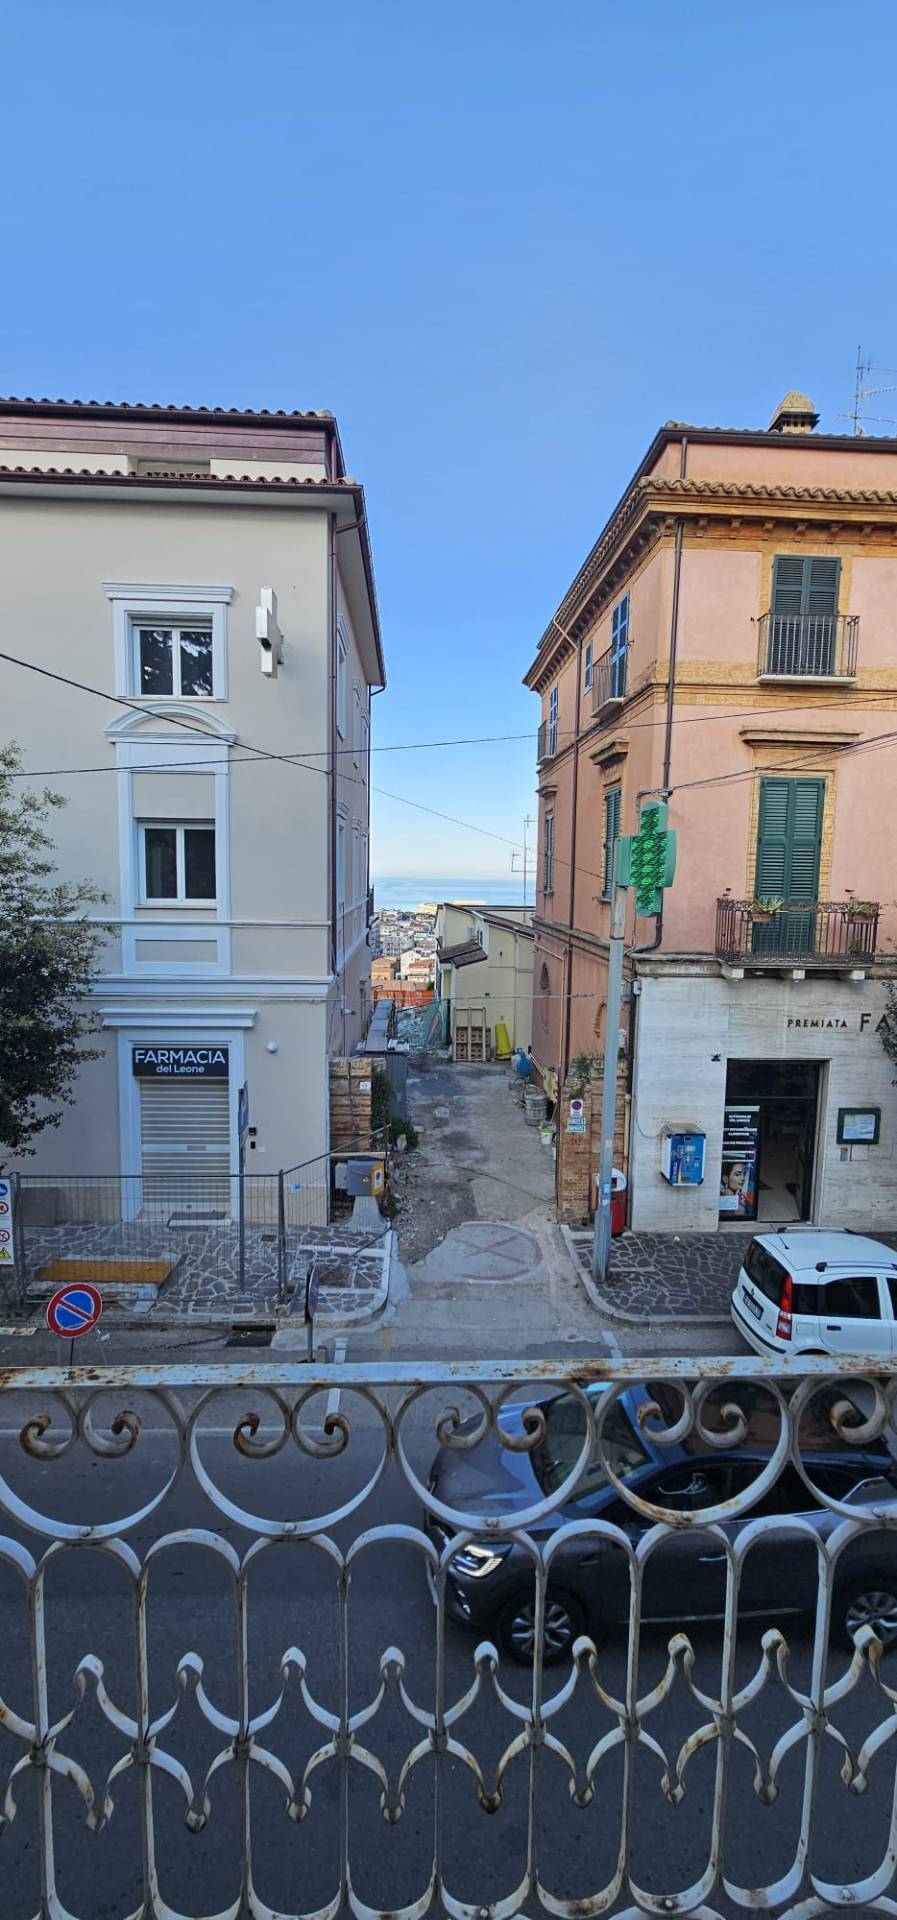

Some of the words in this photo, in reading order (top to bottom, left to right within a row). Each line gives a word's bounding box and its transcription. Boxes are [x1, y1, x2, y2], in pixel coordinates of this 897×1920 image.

[787, 1019, 848, 1028] PREMIATA
[135, 1050, 225, 1063] FARMACIA
[156, 1064, 171, 1073] del
[174, 1064, 205, 1073] Leone
